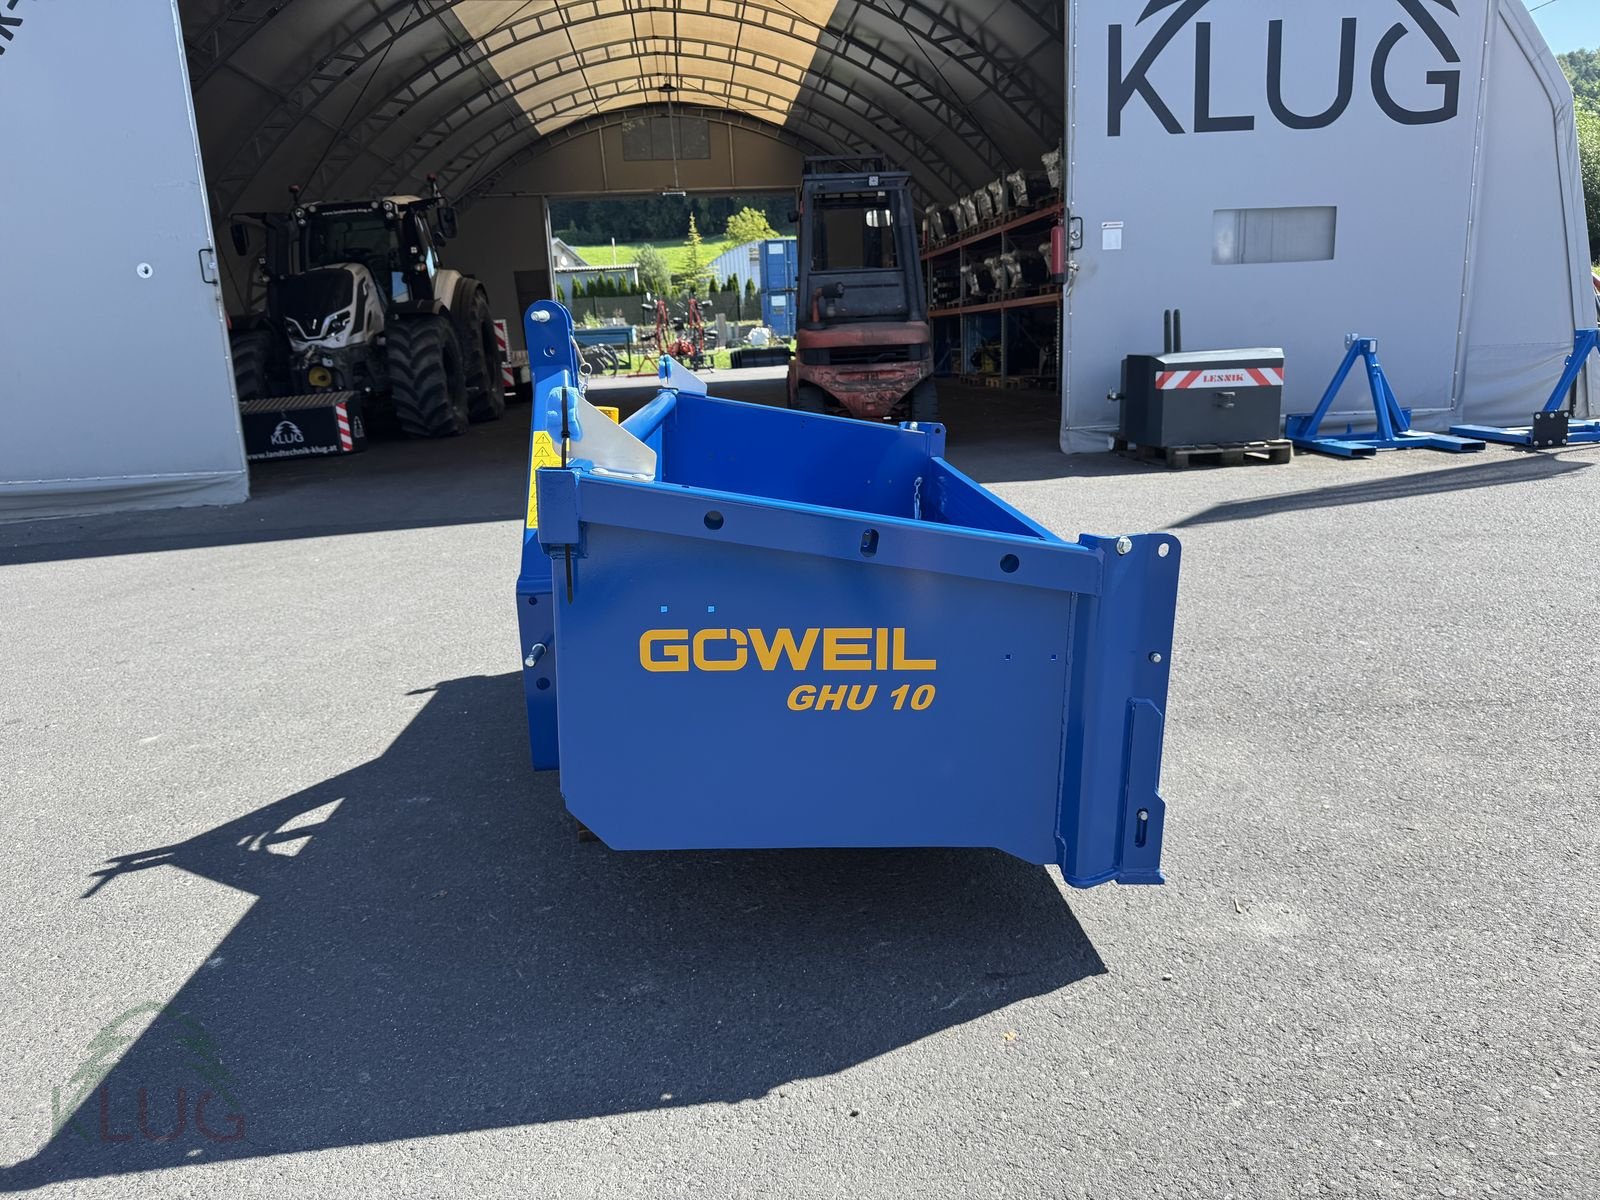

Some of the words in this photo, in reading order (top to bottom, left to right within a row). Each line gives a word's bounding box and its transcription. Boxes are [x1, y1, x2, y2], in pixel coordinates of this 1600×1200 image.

[1107, 17, 1461, 136] KLUG
[1203, 373, 1243, 382] LESNIK
[270, 432, 304, 445] KLUG
[787, 685, 878, 711] GHU
[890, 684, 936, 711] 10
